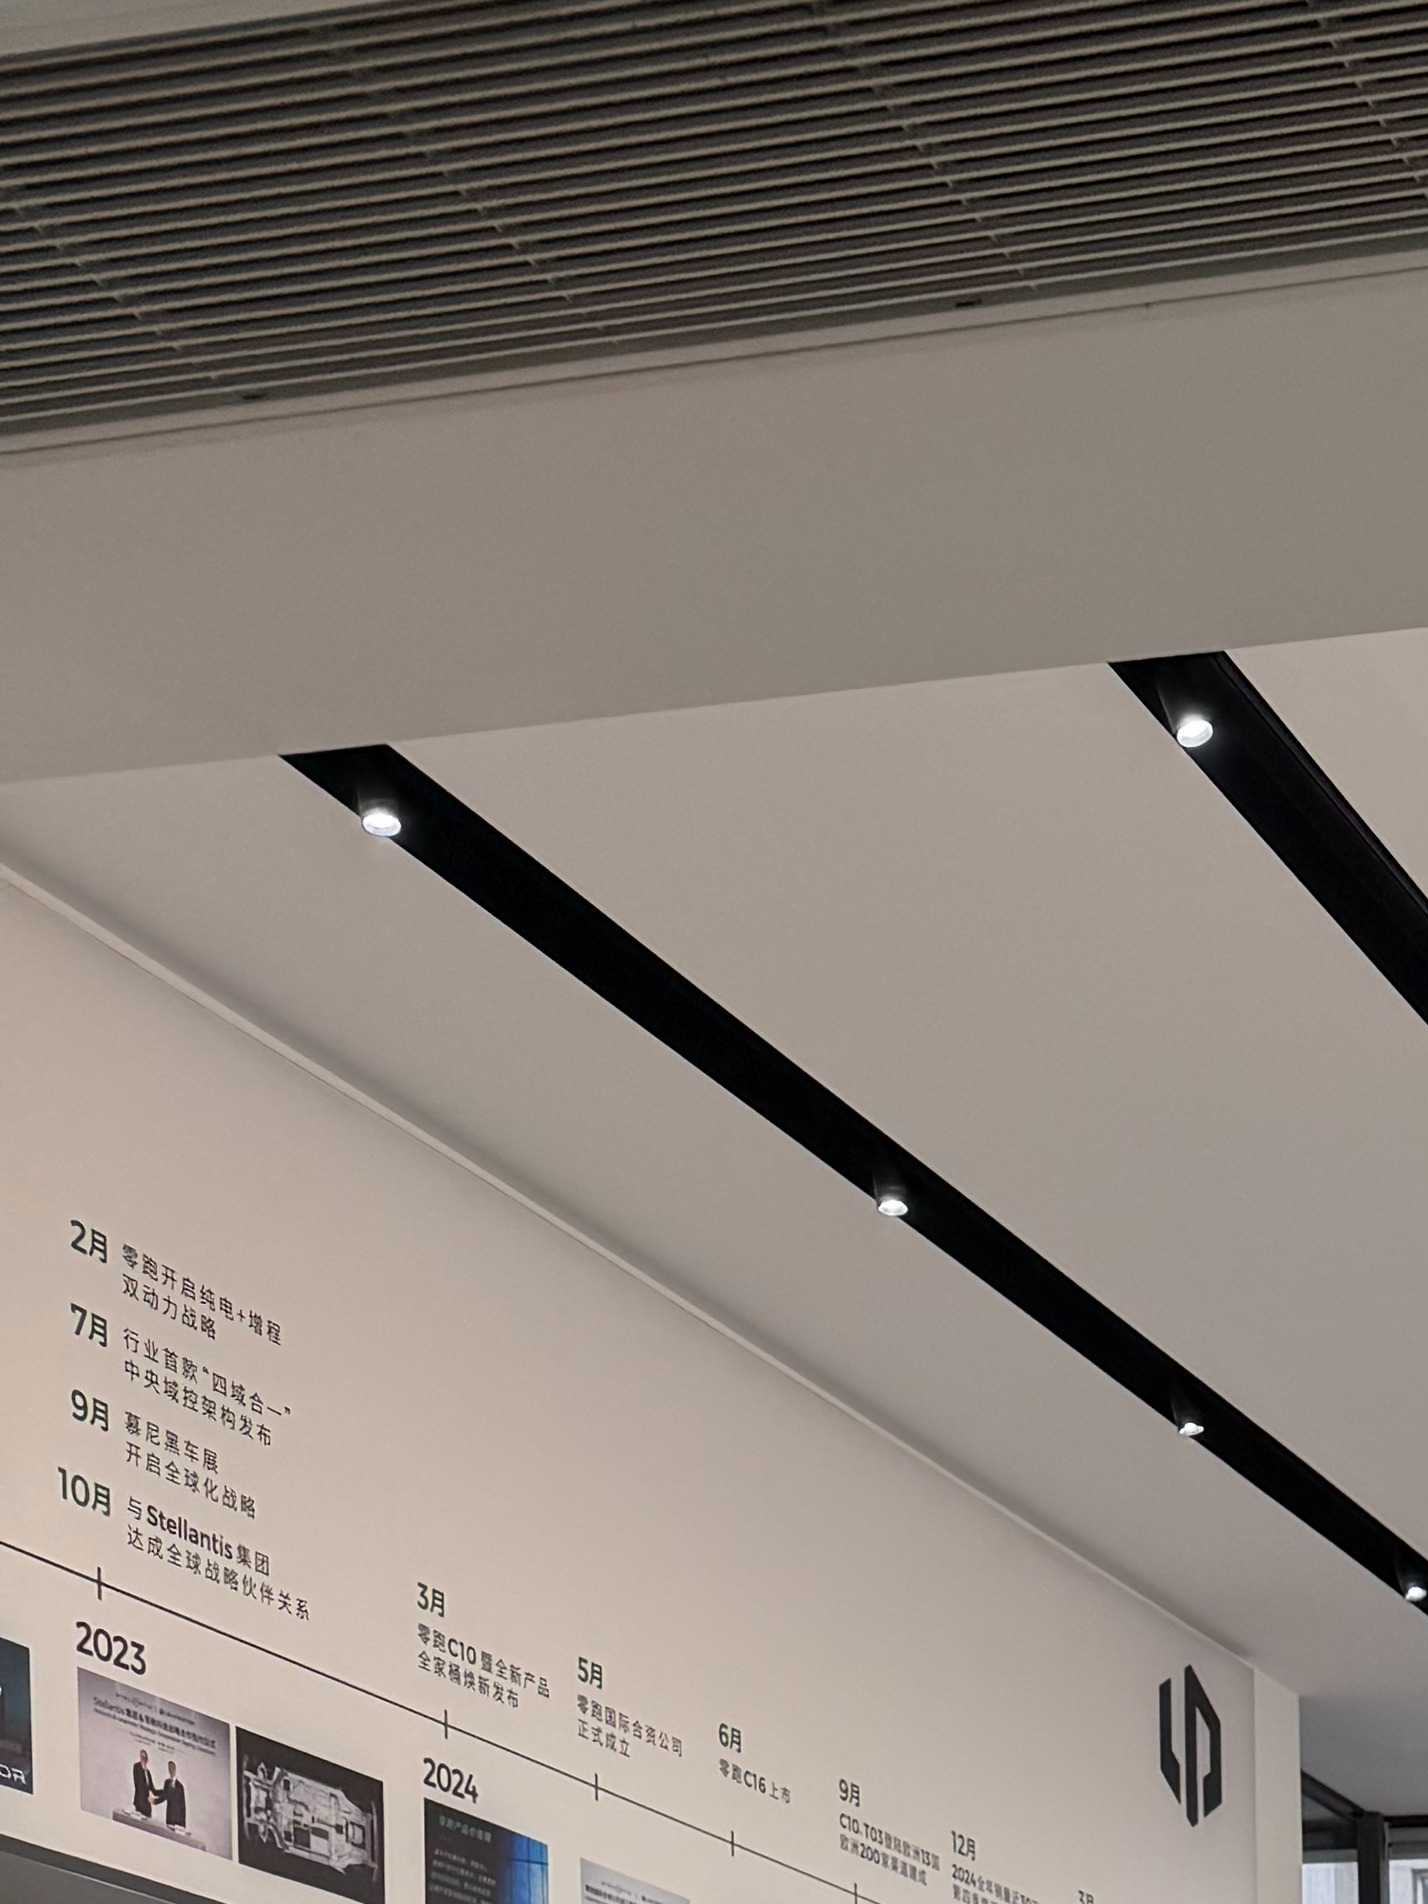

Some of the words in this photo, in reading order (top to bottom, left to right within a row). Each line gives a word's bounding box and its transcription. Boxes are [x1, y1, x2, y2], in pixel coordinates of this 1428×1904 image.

[70, 1219, 108, 1264] 2月
[122, 1243, 281, 1346] 零跑开启纯电+增程
[122, 1273, 216, 1340] 双动力战略
[70, 1302, 108, 1347] 7月
[71, 1389, 109, 1432] 9月
[124, 1359, 271, 1447] 中央域控架构发布
[124, 1411, 219, 1474] 慕尼黑车展
[58, 1466, 111, 1517] 10月
[125, 1441, 256, 1520] 开启全球化战略
[126, 1523, 310, 1621] 达成全球战略伙伴关系
[416, 1582, 445, 1617] 3月
[75, 1621, 147, 1675] 2023
[577, 1656, 603, 1689] 5月
[577, 1694, 683, 1757] 零跑国际合资公司
[577, 1718, 631, 1758] 正式成立
[718, 1722, 742, 1753] 6月
[423, 1757, 479, 1804] 2024
[838, 1778, 861, 1808] 9月
[951, 1830, 976, 1861] 12月
